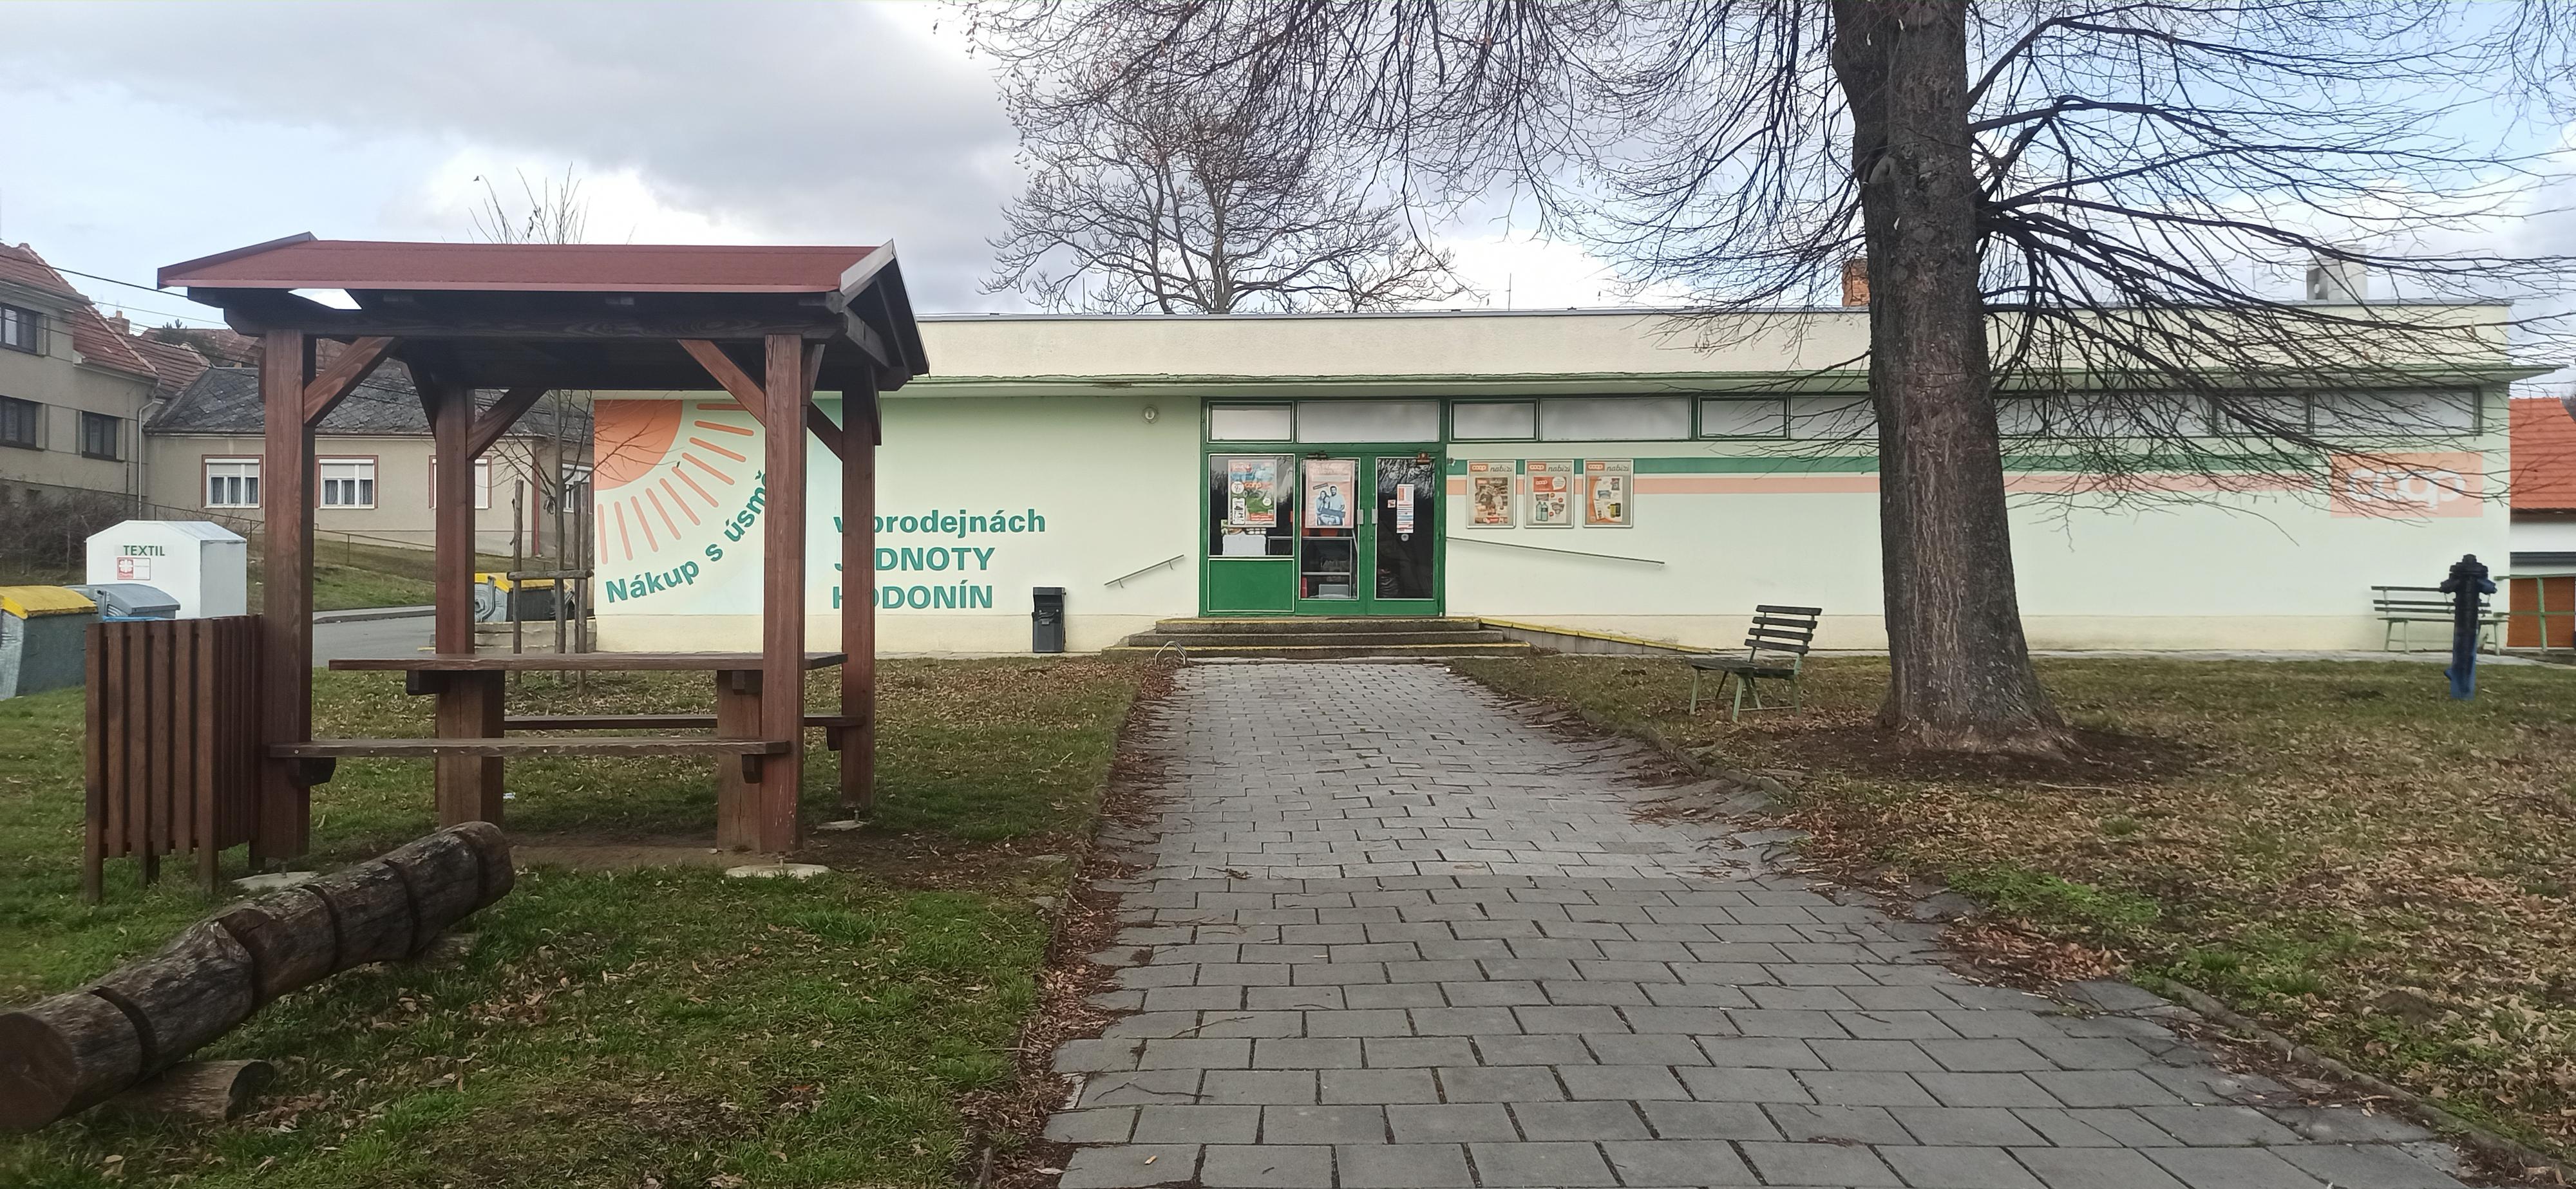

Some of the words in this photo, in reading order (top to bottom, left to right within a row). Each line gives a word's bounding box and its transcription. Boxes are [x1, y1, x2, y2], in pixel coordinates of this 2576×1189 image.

[605, 561, 699, 603] Nákup
[705, 543, 723, 562] s
[724, 470, 766, 542] úsm
[123, 545, 166, 556] TEXTIL
[835, 547, 996, 572] DNOTY
[833, 579, 993, 609] DONÍN
